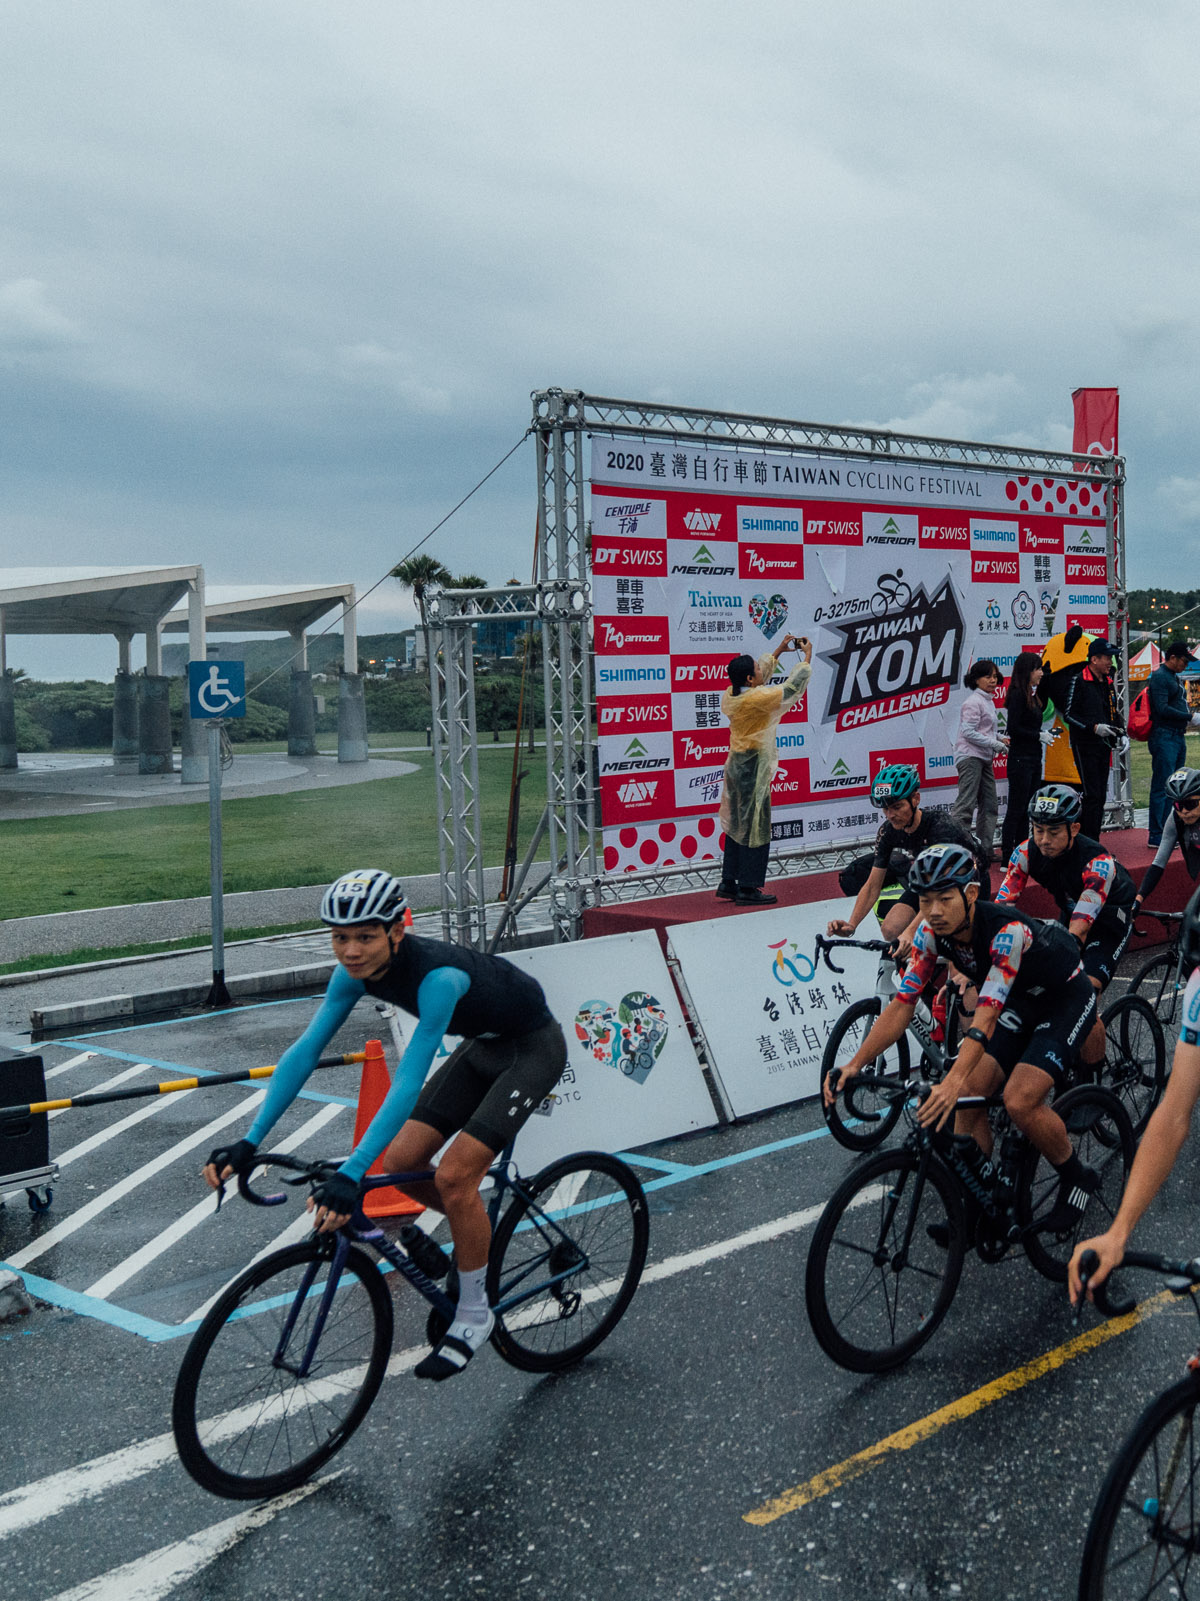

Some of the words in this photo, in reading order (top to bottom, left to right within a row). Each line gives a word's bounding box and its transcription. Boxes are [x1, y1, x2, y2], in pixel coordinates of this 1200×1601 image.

[607, 451, 645, 472] 2020
[650, 451, 768, 486] 臺灣自行車節
[772, 465, 841, 487] TAIWAN
[846, 470, 915, 493] CYCLING
[920, 477, 982, 498] FESTIVAL
[605, 502, 652, 518] CENTUPLE
[742, 518, 799, 532] SHIMANO
[806, 520, 826, 535] DT
[827, 521, 860, 536] SWISS
[866, 535, 917, 546] MERIDA
[921, 526, 938, 539] DT
[939, 527, 968, 541] SWISS
[973, 529, 1016, 542] SHIMANO
[594, 548, 620, 564] DT
[622, 549, 663, 566] SWISS
[1066, 545, 1106, 554] MERIDA
[671, 565, 736, 576] MERIDA
[974, 561, 990, 573] DT
[991, 561, 1017, 574] SWISS
[1067, 564, 1082, 576] DT
[1082, 565, 1106, 577] SWISS
[616, 578, 644, 596] 單車
[616, 597, 645, 615] 喜客
[688, 590, 744, 608] Taiwan
[1068, 594, 1106, 605] SHIMANO
[814, 598, 870, 623] 0-3275m
[688, 620, 743, 633] 交通部觀光局
[855, 613, 926, 645] TAIWAN
[600, 667, 666, 682] SHIMANO
[675, 665, 699, 681] DT
[700, 665, 729, 680] SWIS
[840, 629, 957, 704] KOM
[695, 693, 720, 710] 單車
[840, 686, 946, 728] CHALLENGE
[600, 707, 624, 723] DT
[626, 705, 668, 722] SWISS
[695, 711, 721, 728] 喜客
[602, 757, 670, 773] MERIDA
[928, 755, 954, 768] SHIM
[689, 769, 725, 788] CENTUPL
[813, 775, 868, 789] MERIDA
[1039, 800, 1056, 812] 39
[771, 822, 803, 839] 導單位
[340, 883, 364, 893] 15
[1067, 993, 1096, 1046] cannondale
[767, 1063, 786, 1074] 2015
[788, 1055, 820, 1069] TAIWAN
[555, 1090, 582, 1105] OTC
